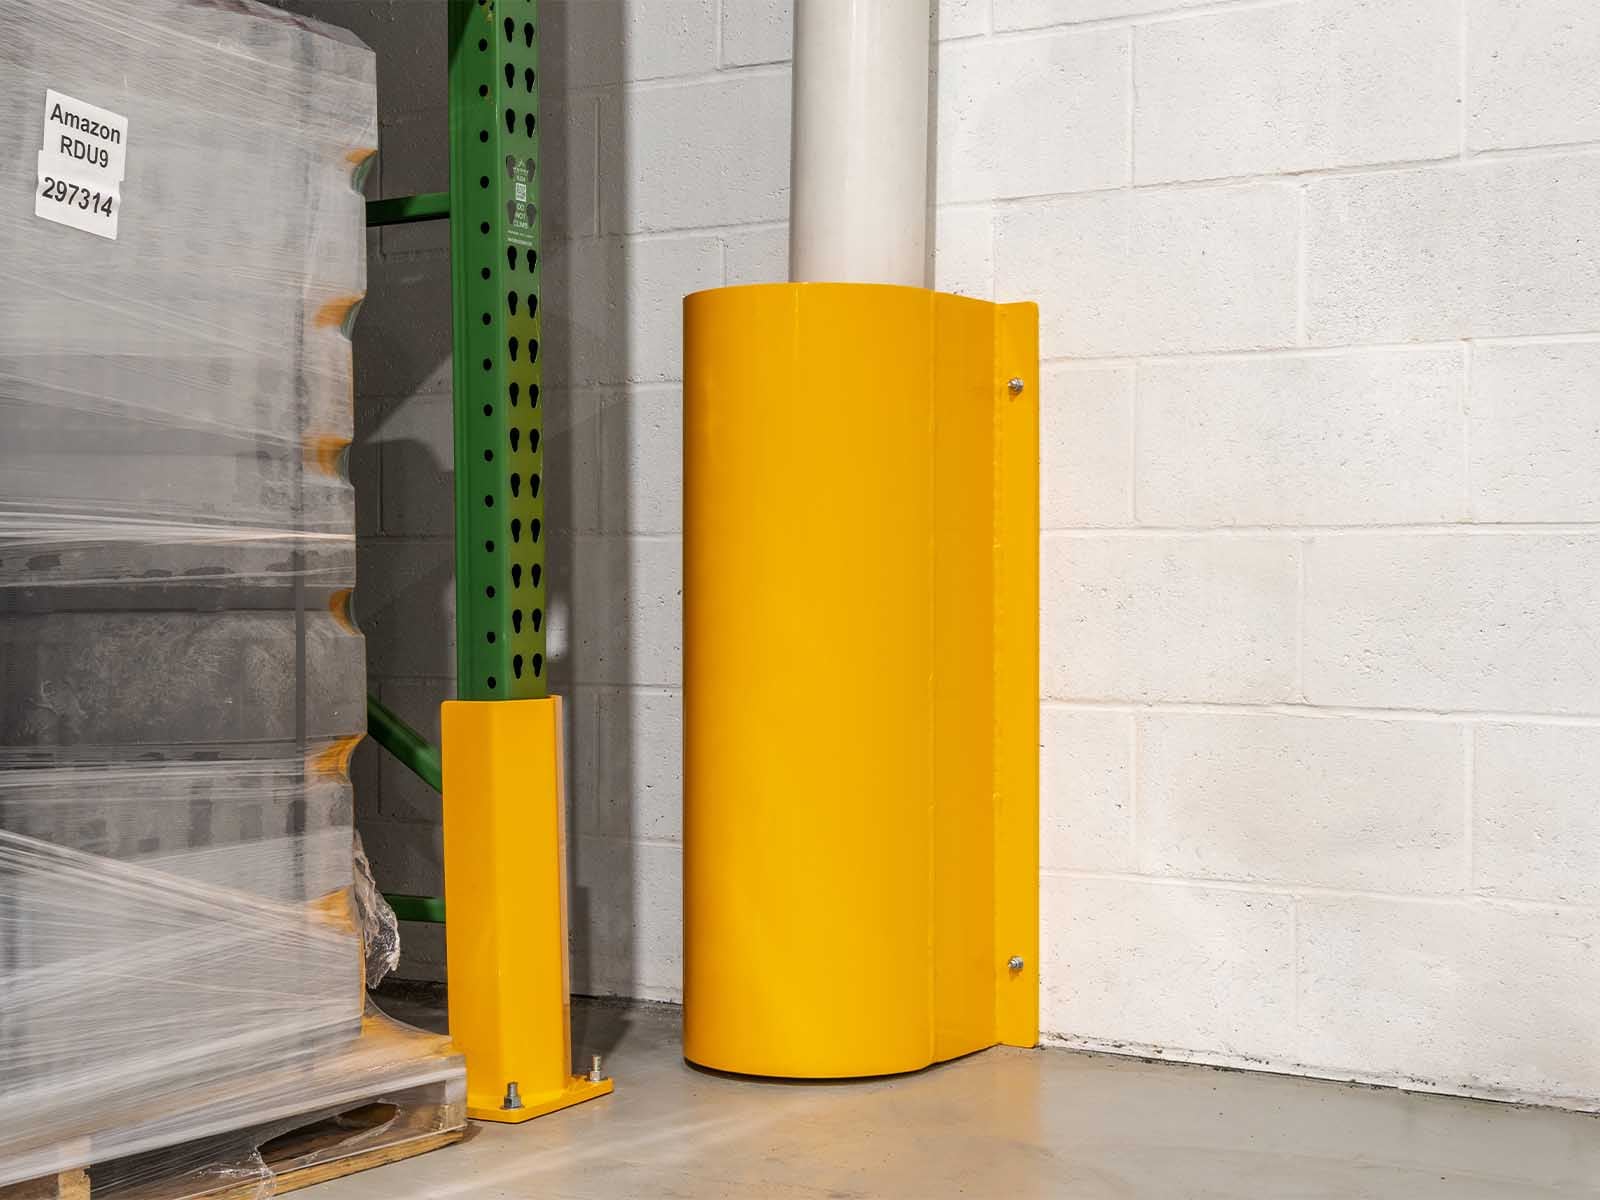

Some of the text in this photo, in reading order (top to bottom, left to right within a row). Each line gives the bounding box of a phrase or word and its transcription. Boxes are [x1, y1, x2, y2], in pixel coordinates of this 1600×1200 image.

[50, 103, 120, 144] Amazon
[60, 135, 109, 168] RDU9
[42, 177, 113, 217] 297314
